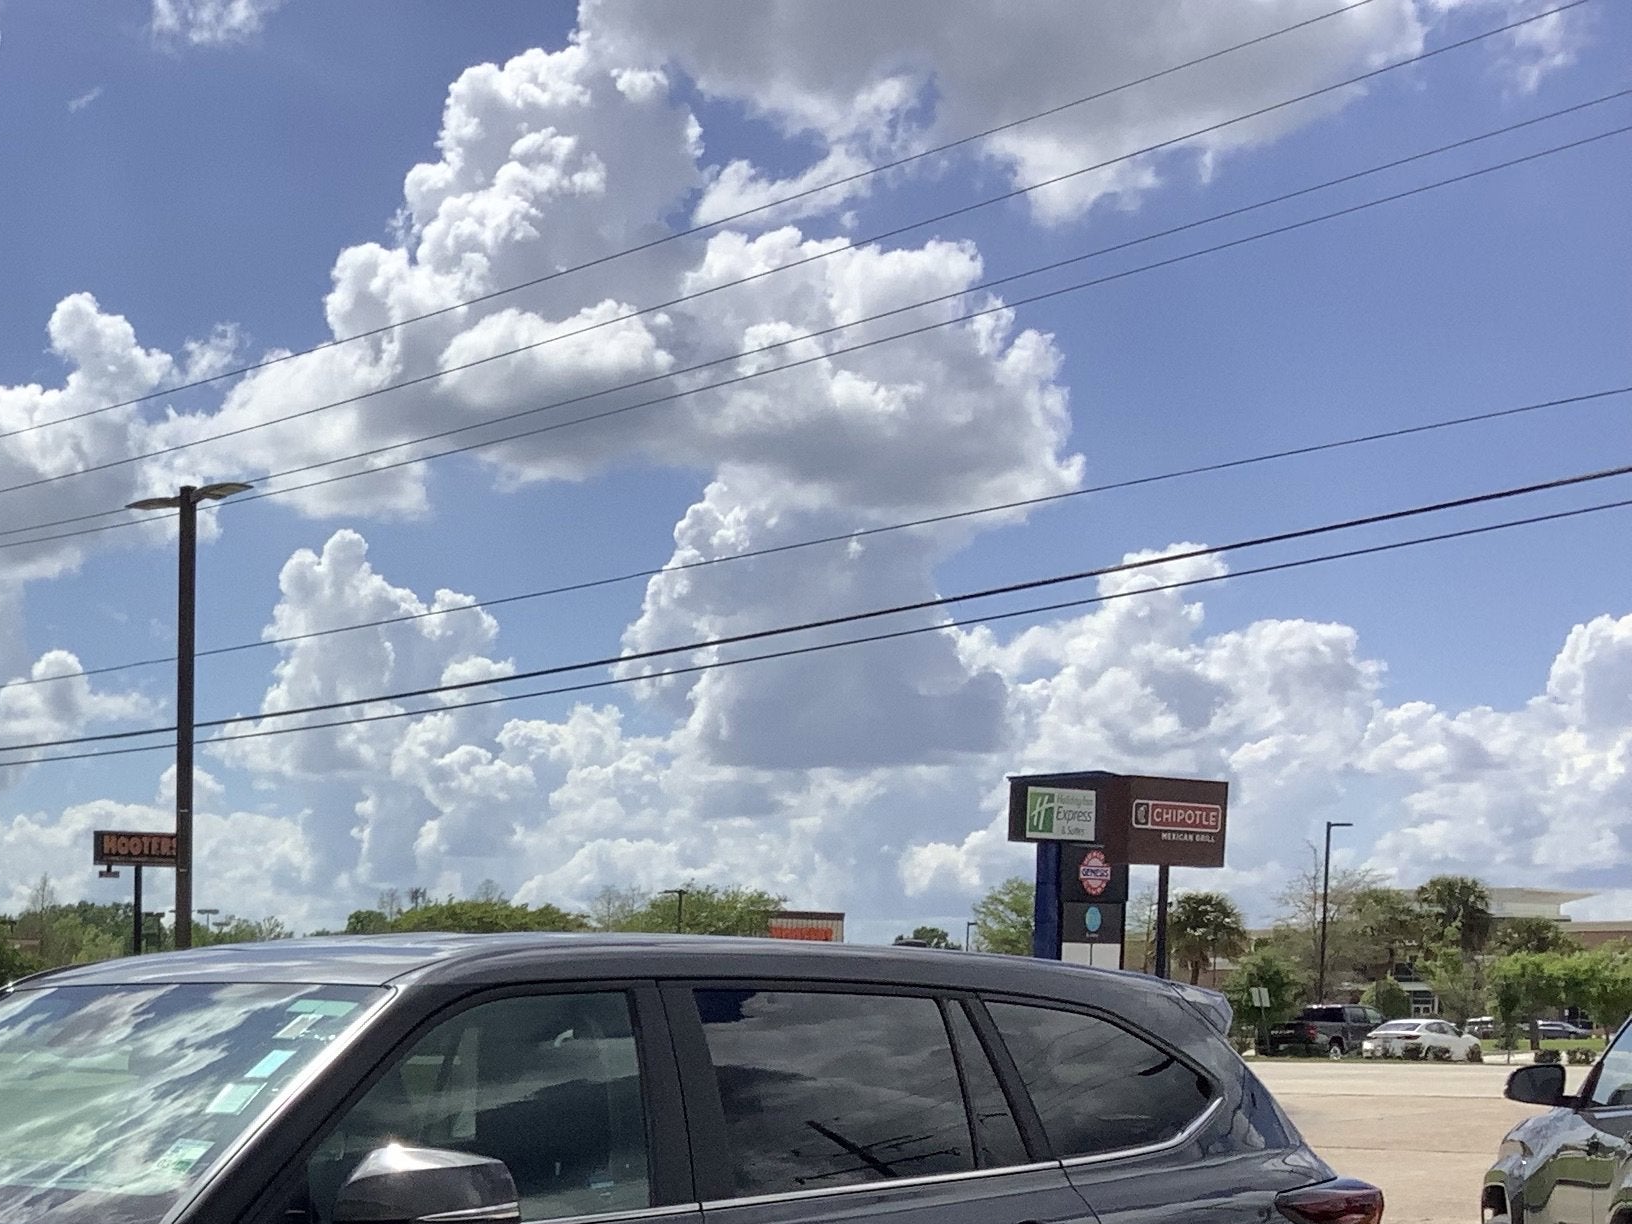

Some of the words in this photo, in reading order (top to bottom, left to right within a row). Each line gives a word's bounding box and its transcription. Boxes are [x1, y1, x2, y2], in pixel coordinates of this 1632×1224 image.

[1056, 805, 1093, 824] Express
[1153, 807, 1218, 826] CHIPOTLE
[1161, 832, 1194, 842] MEXICAN
